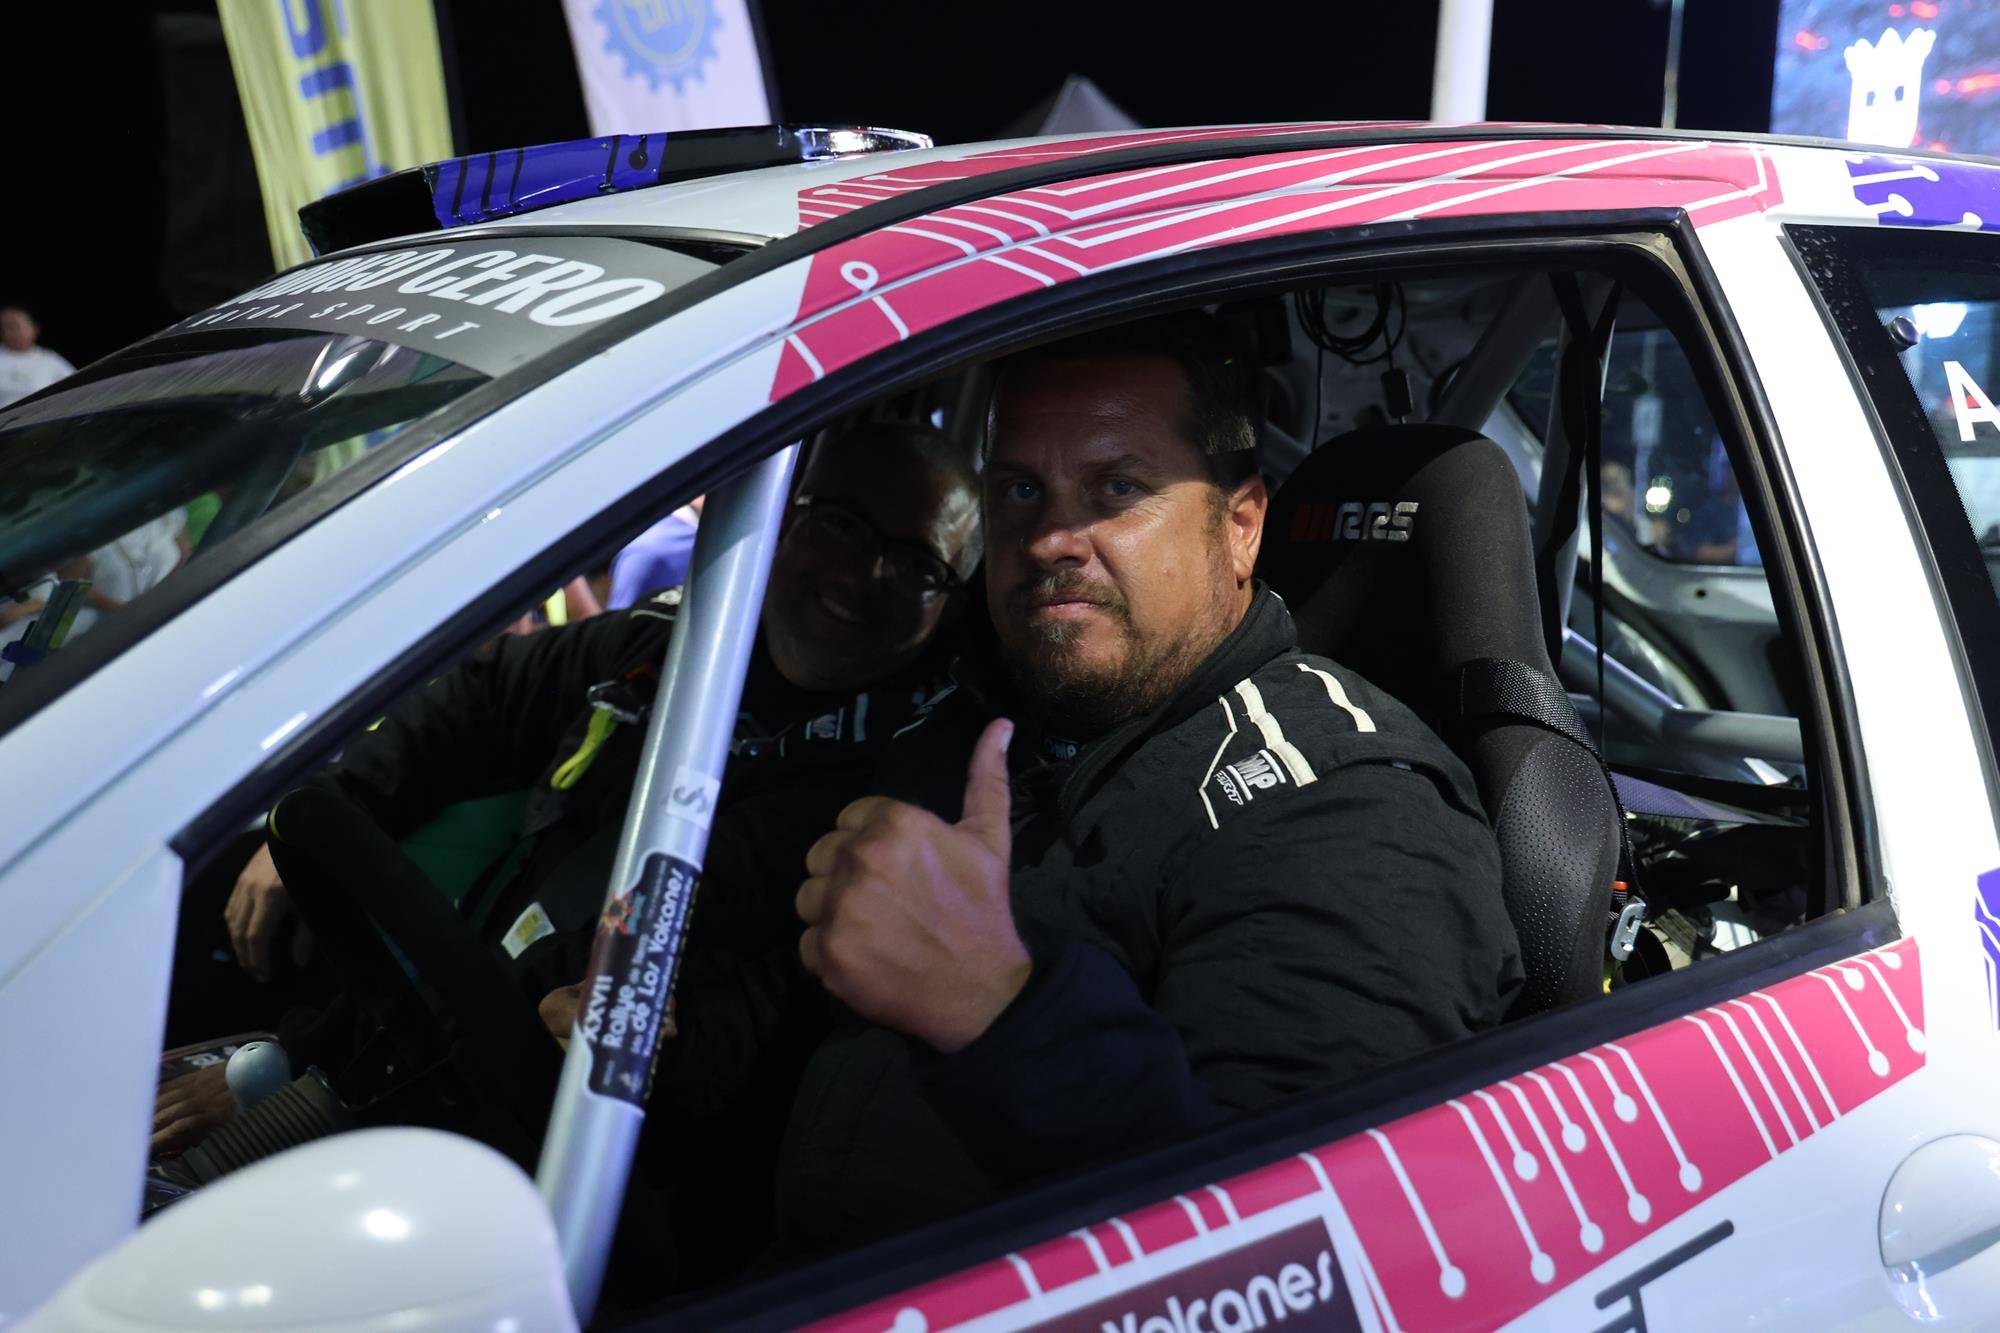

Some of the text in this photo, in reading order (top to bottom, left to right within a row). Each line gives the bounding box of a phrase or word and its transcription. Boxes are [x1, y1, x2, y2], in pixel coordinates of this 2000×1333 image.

[398, 250, 666, 327] CERO
[309, 302, 481, 340] SPORT
[1332, 501, 1420, 541] RRS
[647, 867, 684, 953] Volcanes
[638, 961, 661, 997] Los
[583, 975, 614, 1042] XXVII
[602, 985, 637, 1048] Rallye
[631, 1002, 652, 1032] de
